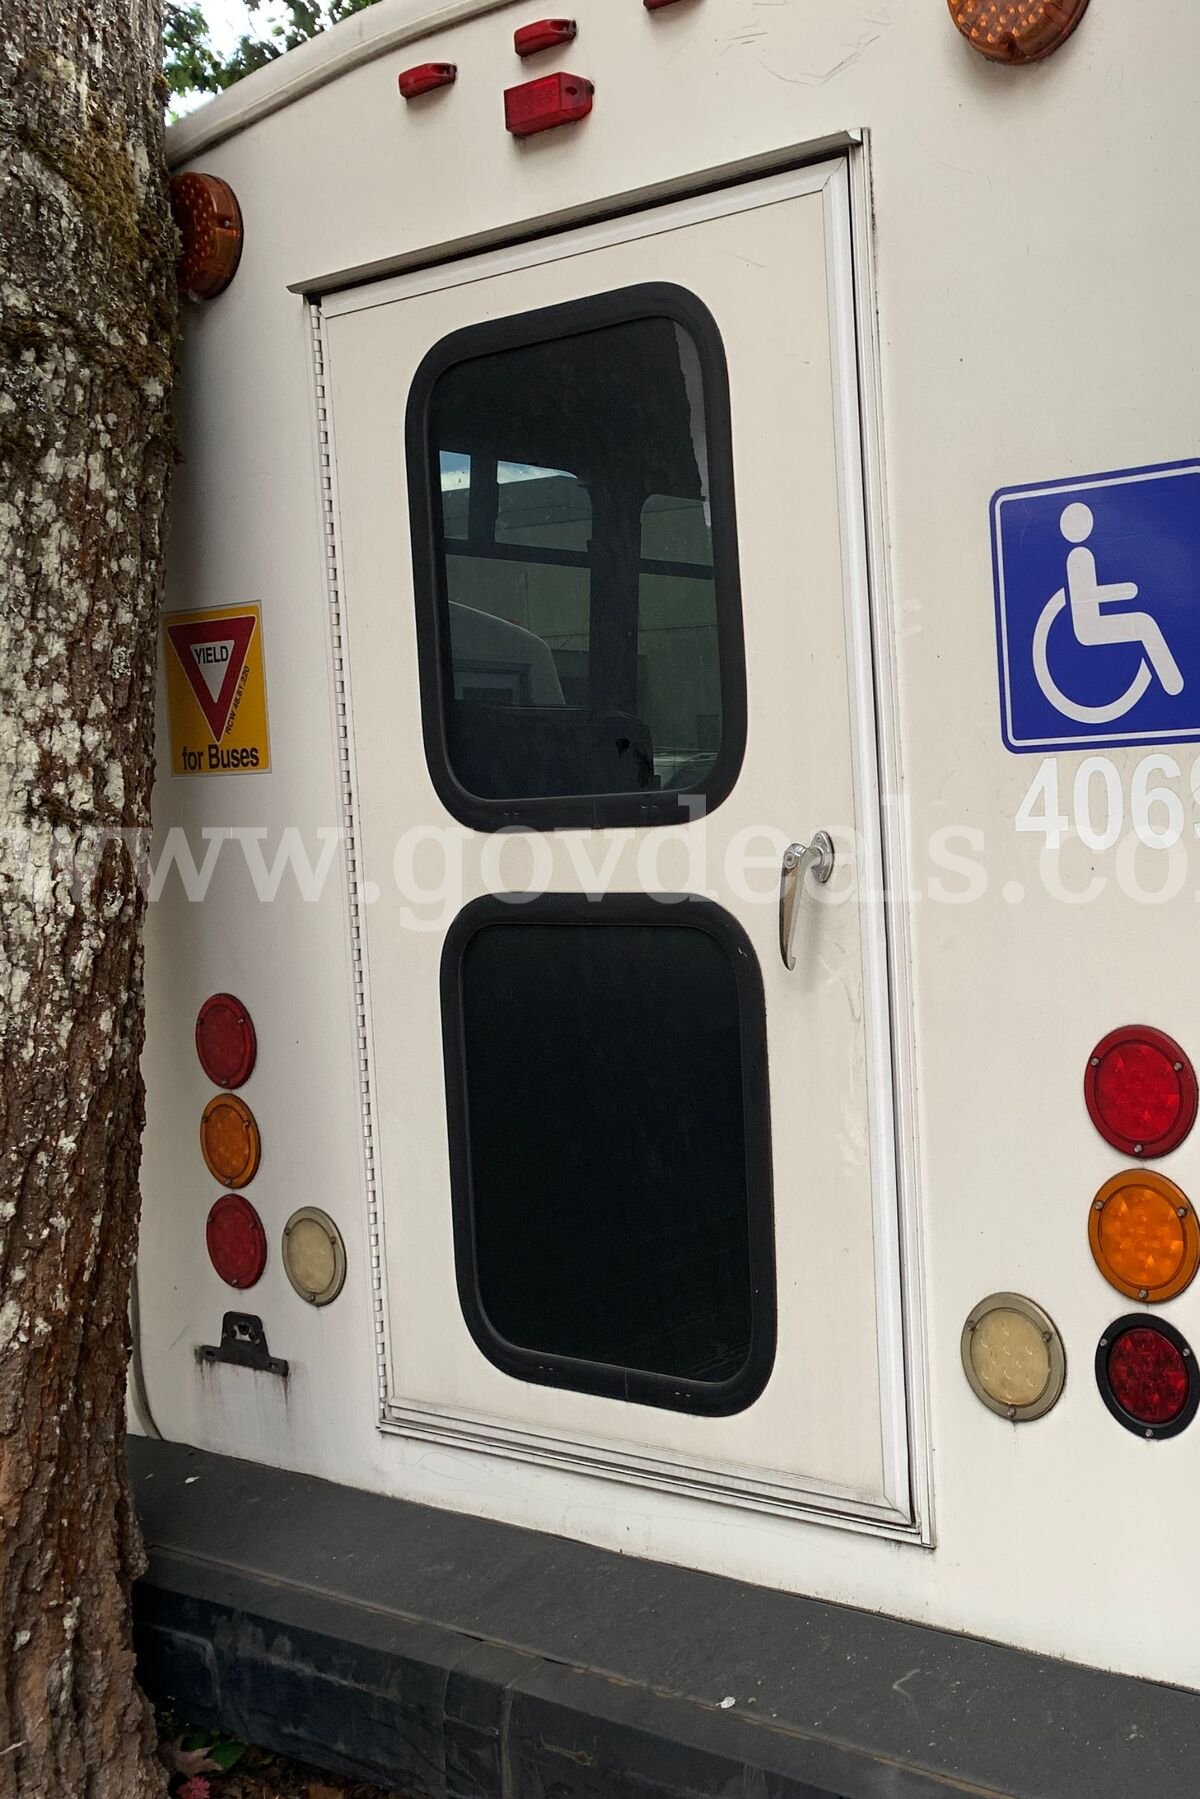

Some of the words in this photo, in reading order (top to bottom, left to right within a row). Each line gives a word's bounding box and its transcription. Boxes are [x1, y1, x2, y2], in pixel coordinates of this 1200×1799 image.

[194, 646, 229, 664] YIELD
[226, 710, 236, 735] RCW
[182, 746, 204, 770] for
[208, 744, 259, 769] Buses
